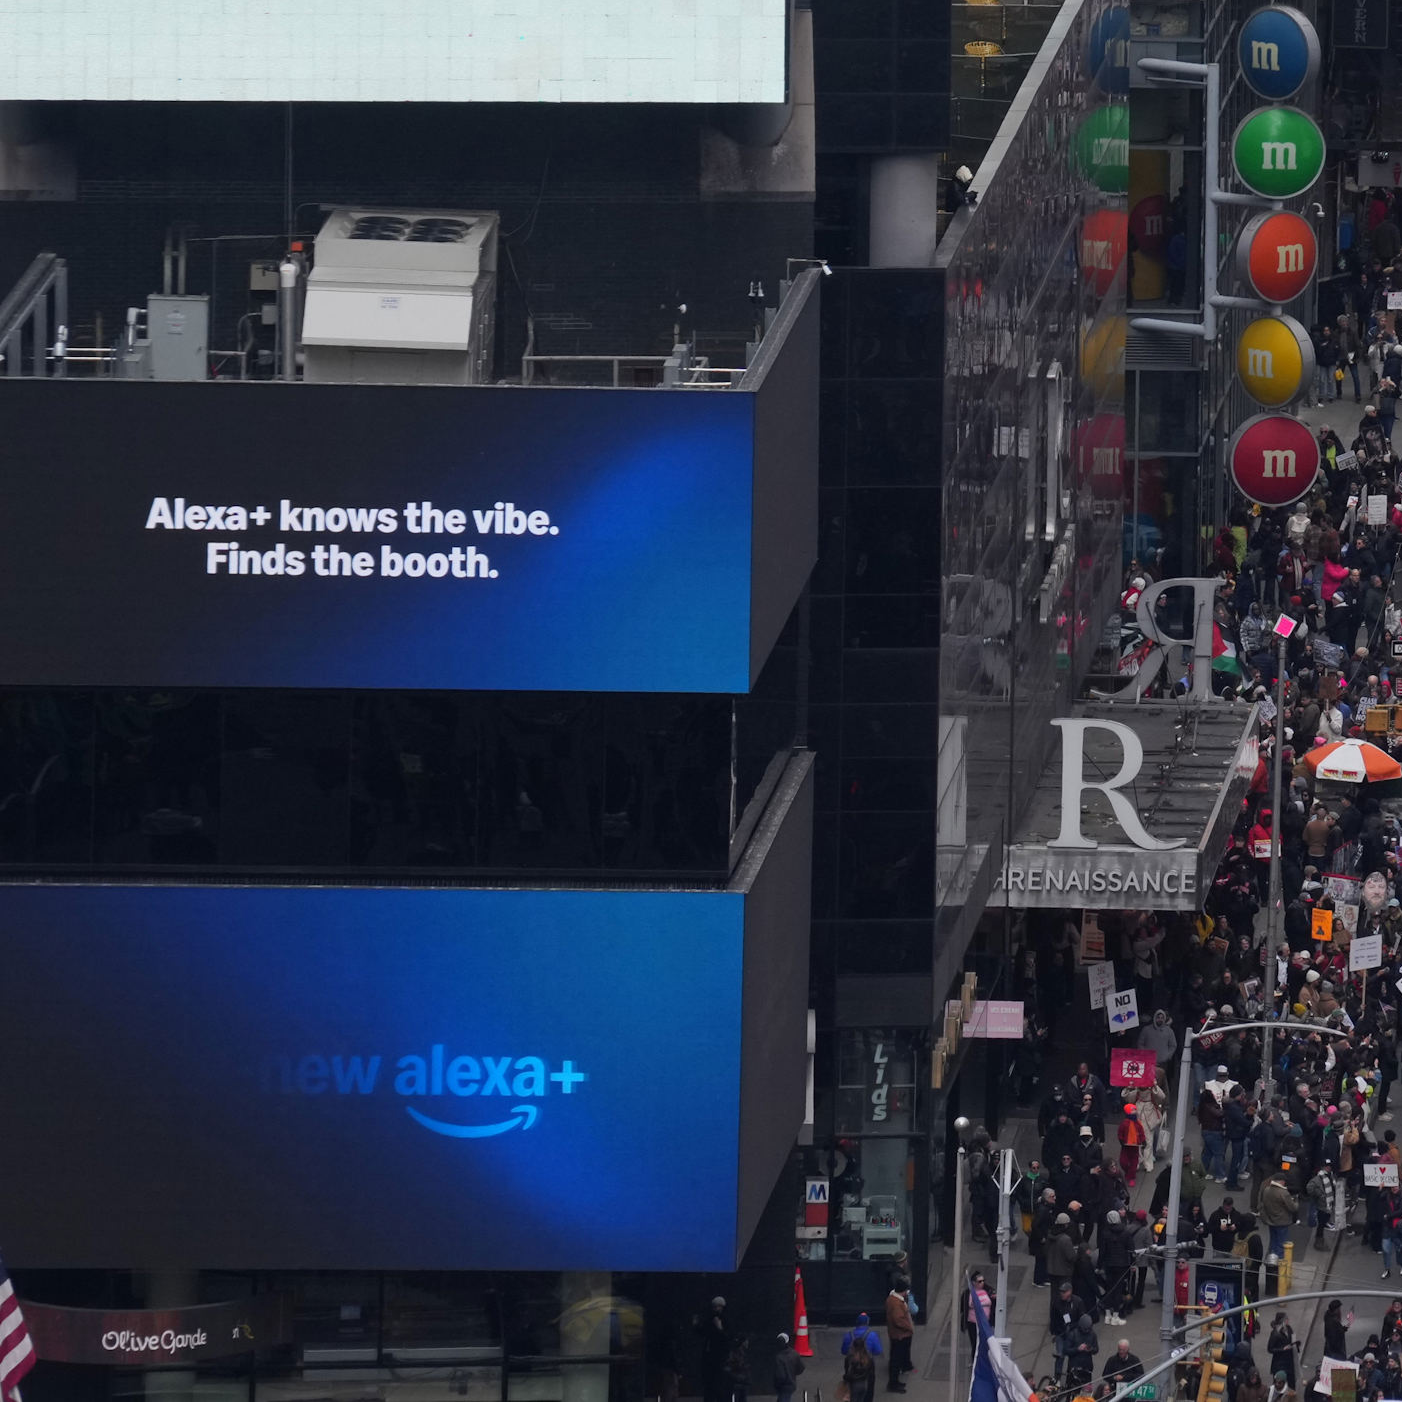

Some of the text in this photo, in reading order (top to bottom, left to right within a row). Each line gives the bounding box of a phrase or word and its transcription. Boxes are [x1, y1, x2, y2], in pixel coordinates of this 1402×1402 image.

[1251, 39, 1280, 71] m
[1262, 141, 1297, 170] m
[1276, 244, 1304, 273] m
[1248, 348, 1275, 379] m
[1263, 448, 1297, 478] m
[146, 498, 559, 536] Alexa+ knows the vibe.
[207, 542, 499, 578] Finds the booth.
[1047, 717, 1187, 851] R
[1009, 869, 1196, 895] RENAISSANCE
[1114, 995, 1131, 1007] NO
[395, 1044, 586, 1097] alexa+
[871, 1044, 889, 1121] Lids
[807, 1184, 827, 1201] M
[1136, 1385, 1148, 1397] 47
